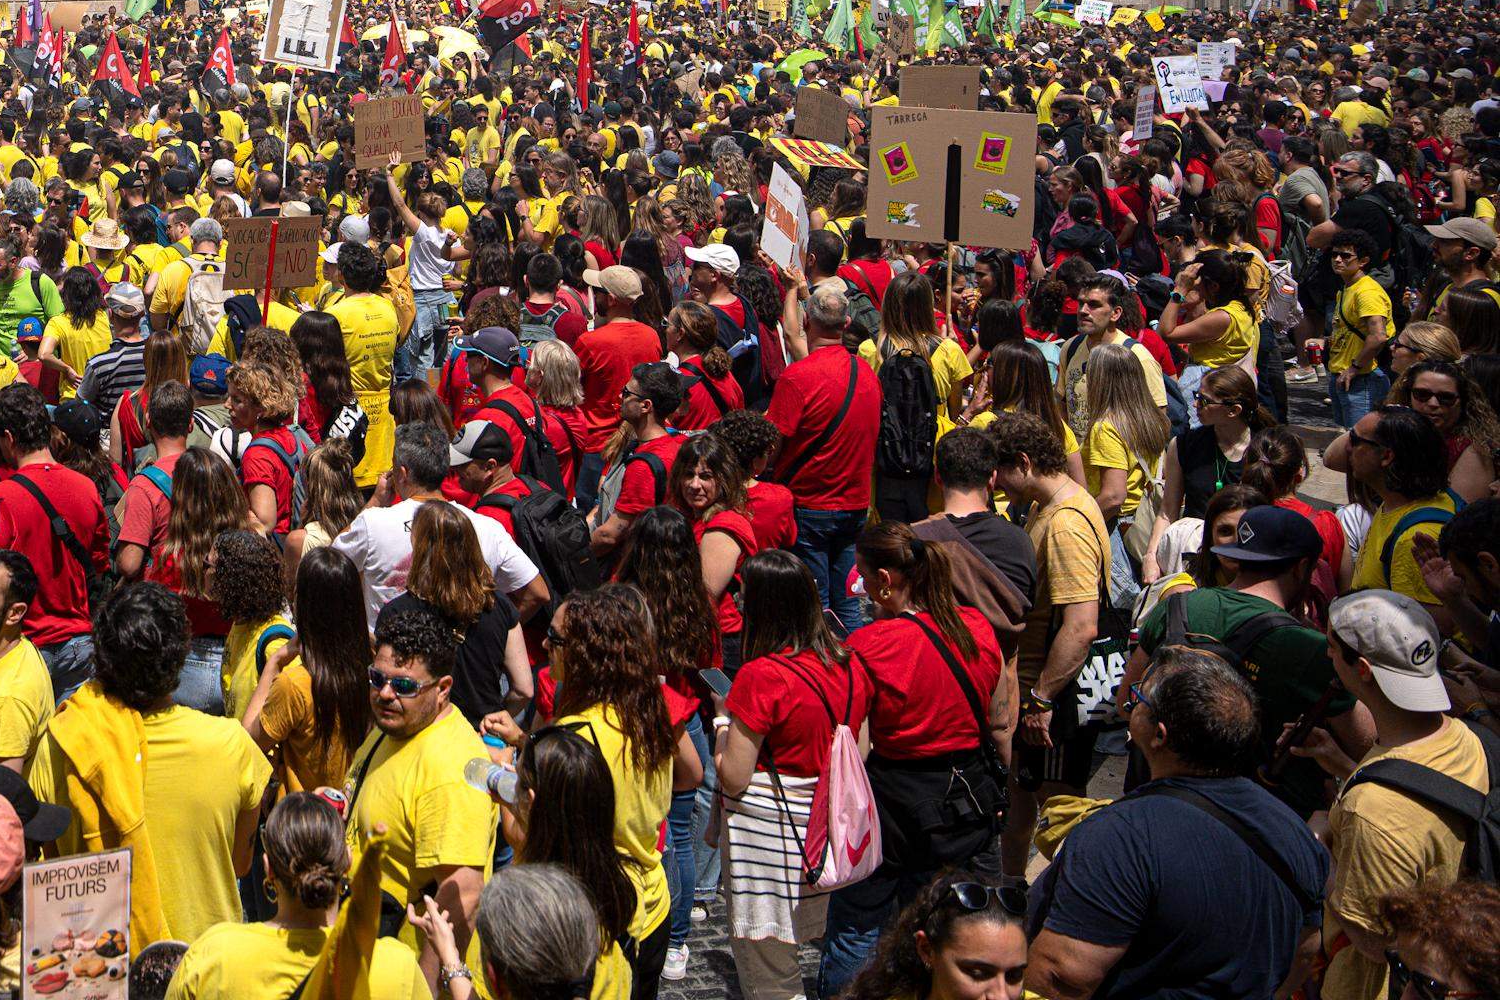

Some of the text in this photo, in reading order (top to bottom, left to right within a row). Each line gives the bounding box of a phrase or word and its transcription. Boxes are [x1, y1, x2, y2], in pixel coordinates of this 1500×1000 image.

[364, 123, 392, 141] DIGNA
[362, 139, 405, 158] QUALITAT
[232, 247, 308, 279] SÍ NO
[32, 859, 120, 886] IMPROVISEM
[45, 878, 107, 903] FUTURS
